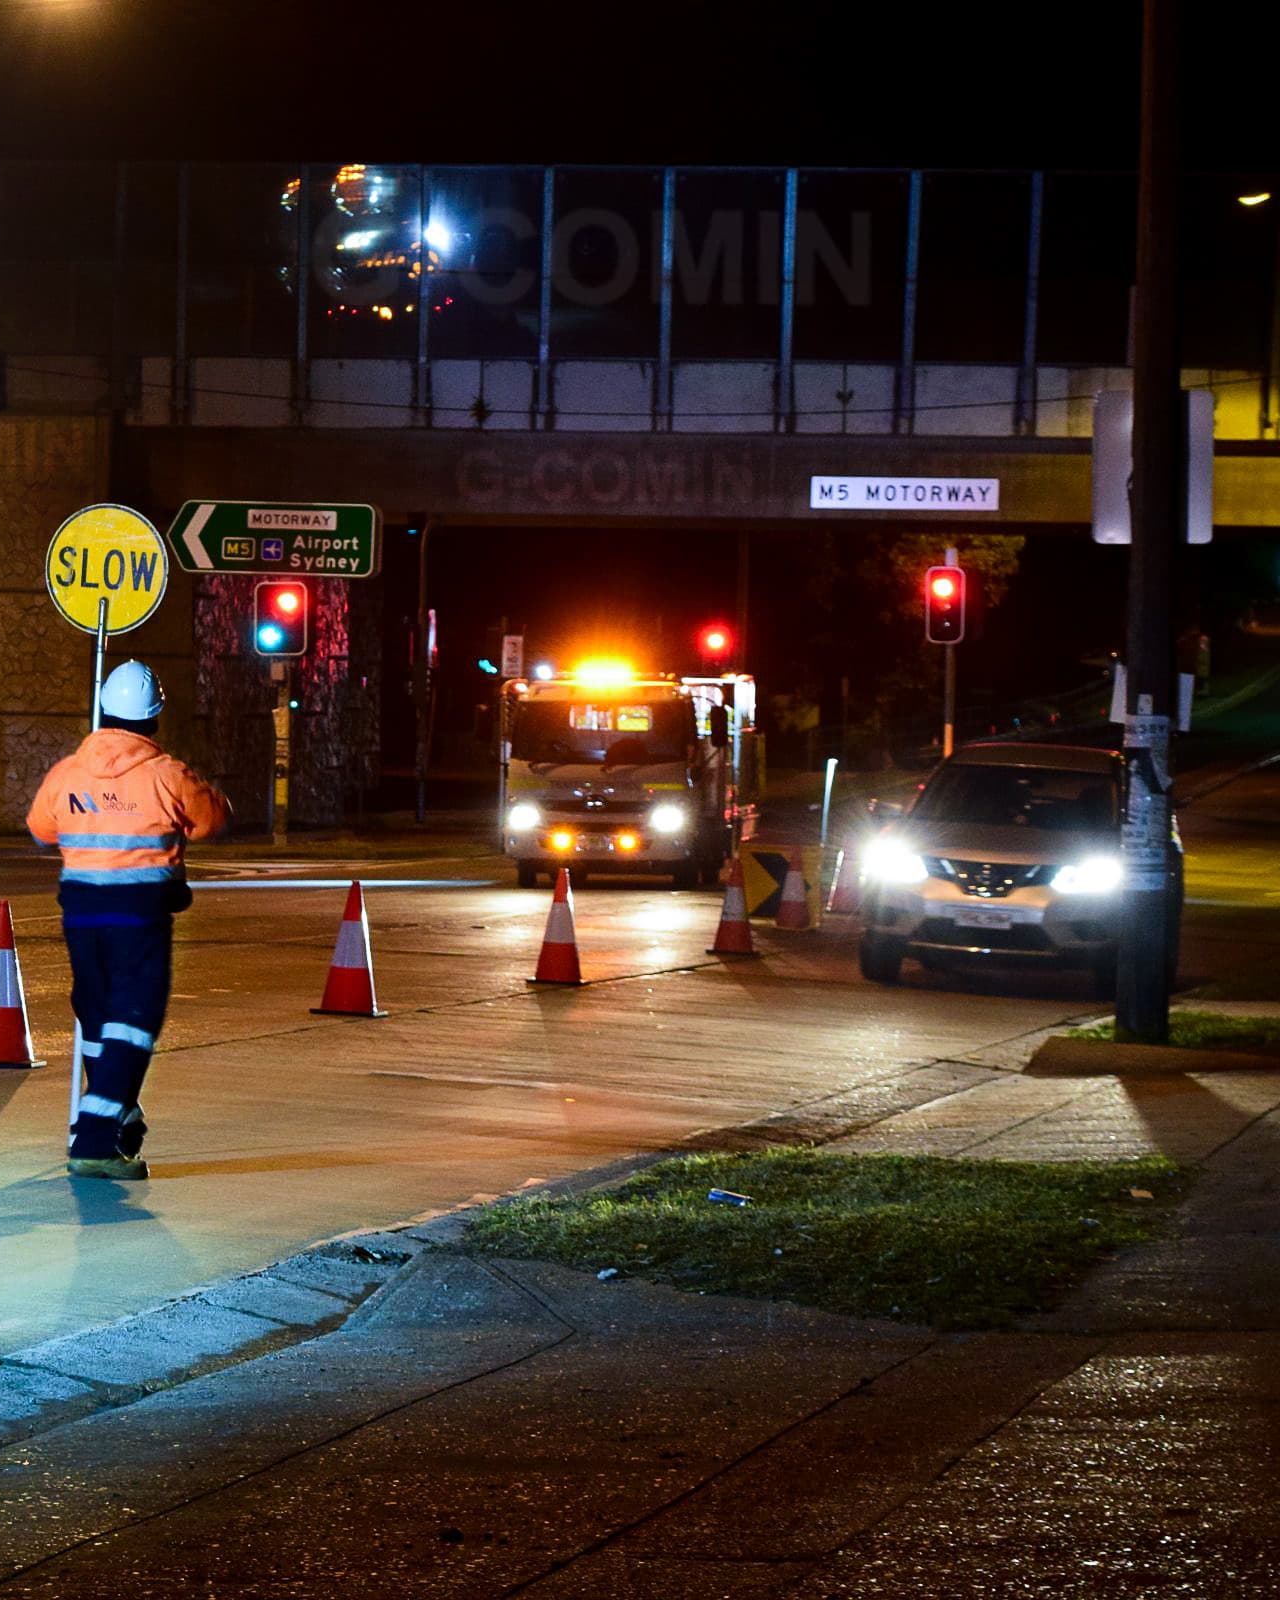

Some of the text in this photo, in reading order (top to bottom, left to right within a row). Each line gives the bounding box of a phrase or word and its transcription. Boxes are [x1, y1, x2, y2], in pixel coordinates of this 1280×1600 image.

[819, 484, 991, 502] M5 MOTORWAY
[252, 513, 331, 526] MOTORWAY
[226, 542, 250, 555] M5
[293, 535, 360, 551] Airport
[56, 546, 158, 592] SLOW
[290, 553, 360, 572] Sydney
[102, 792, 118, 802] NA
[103, 801, 138, 812] GROUP
